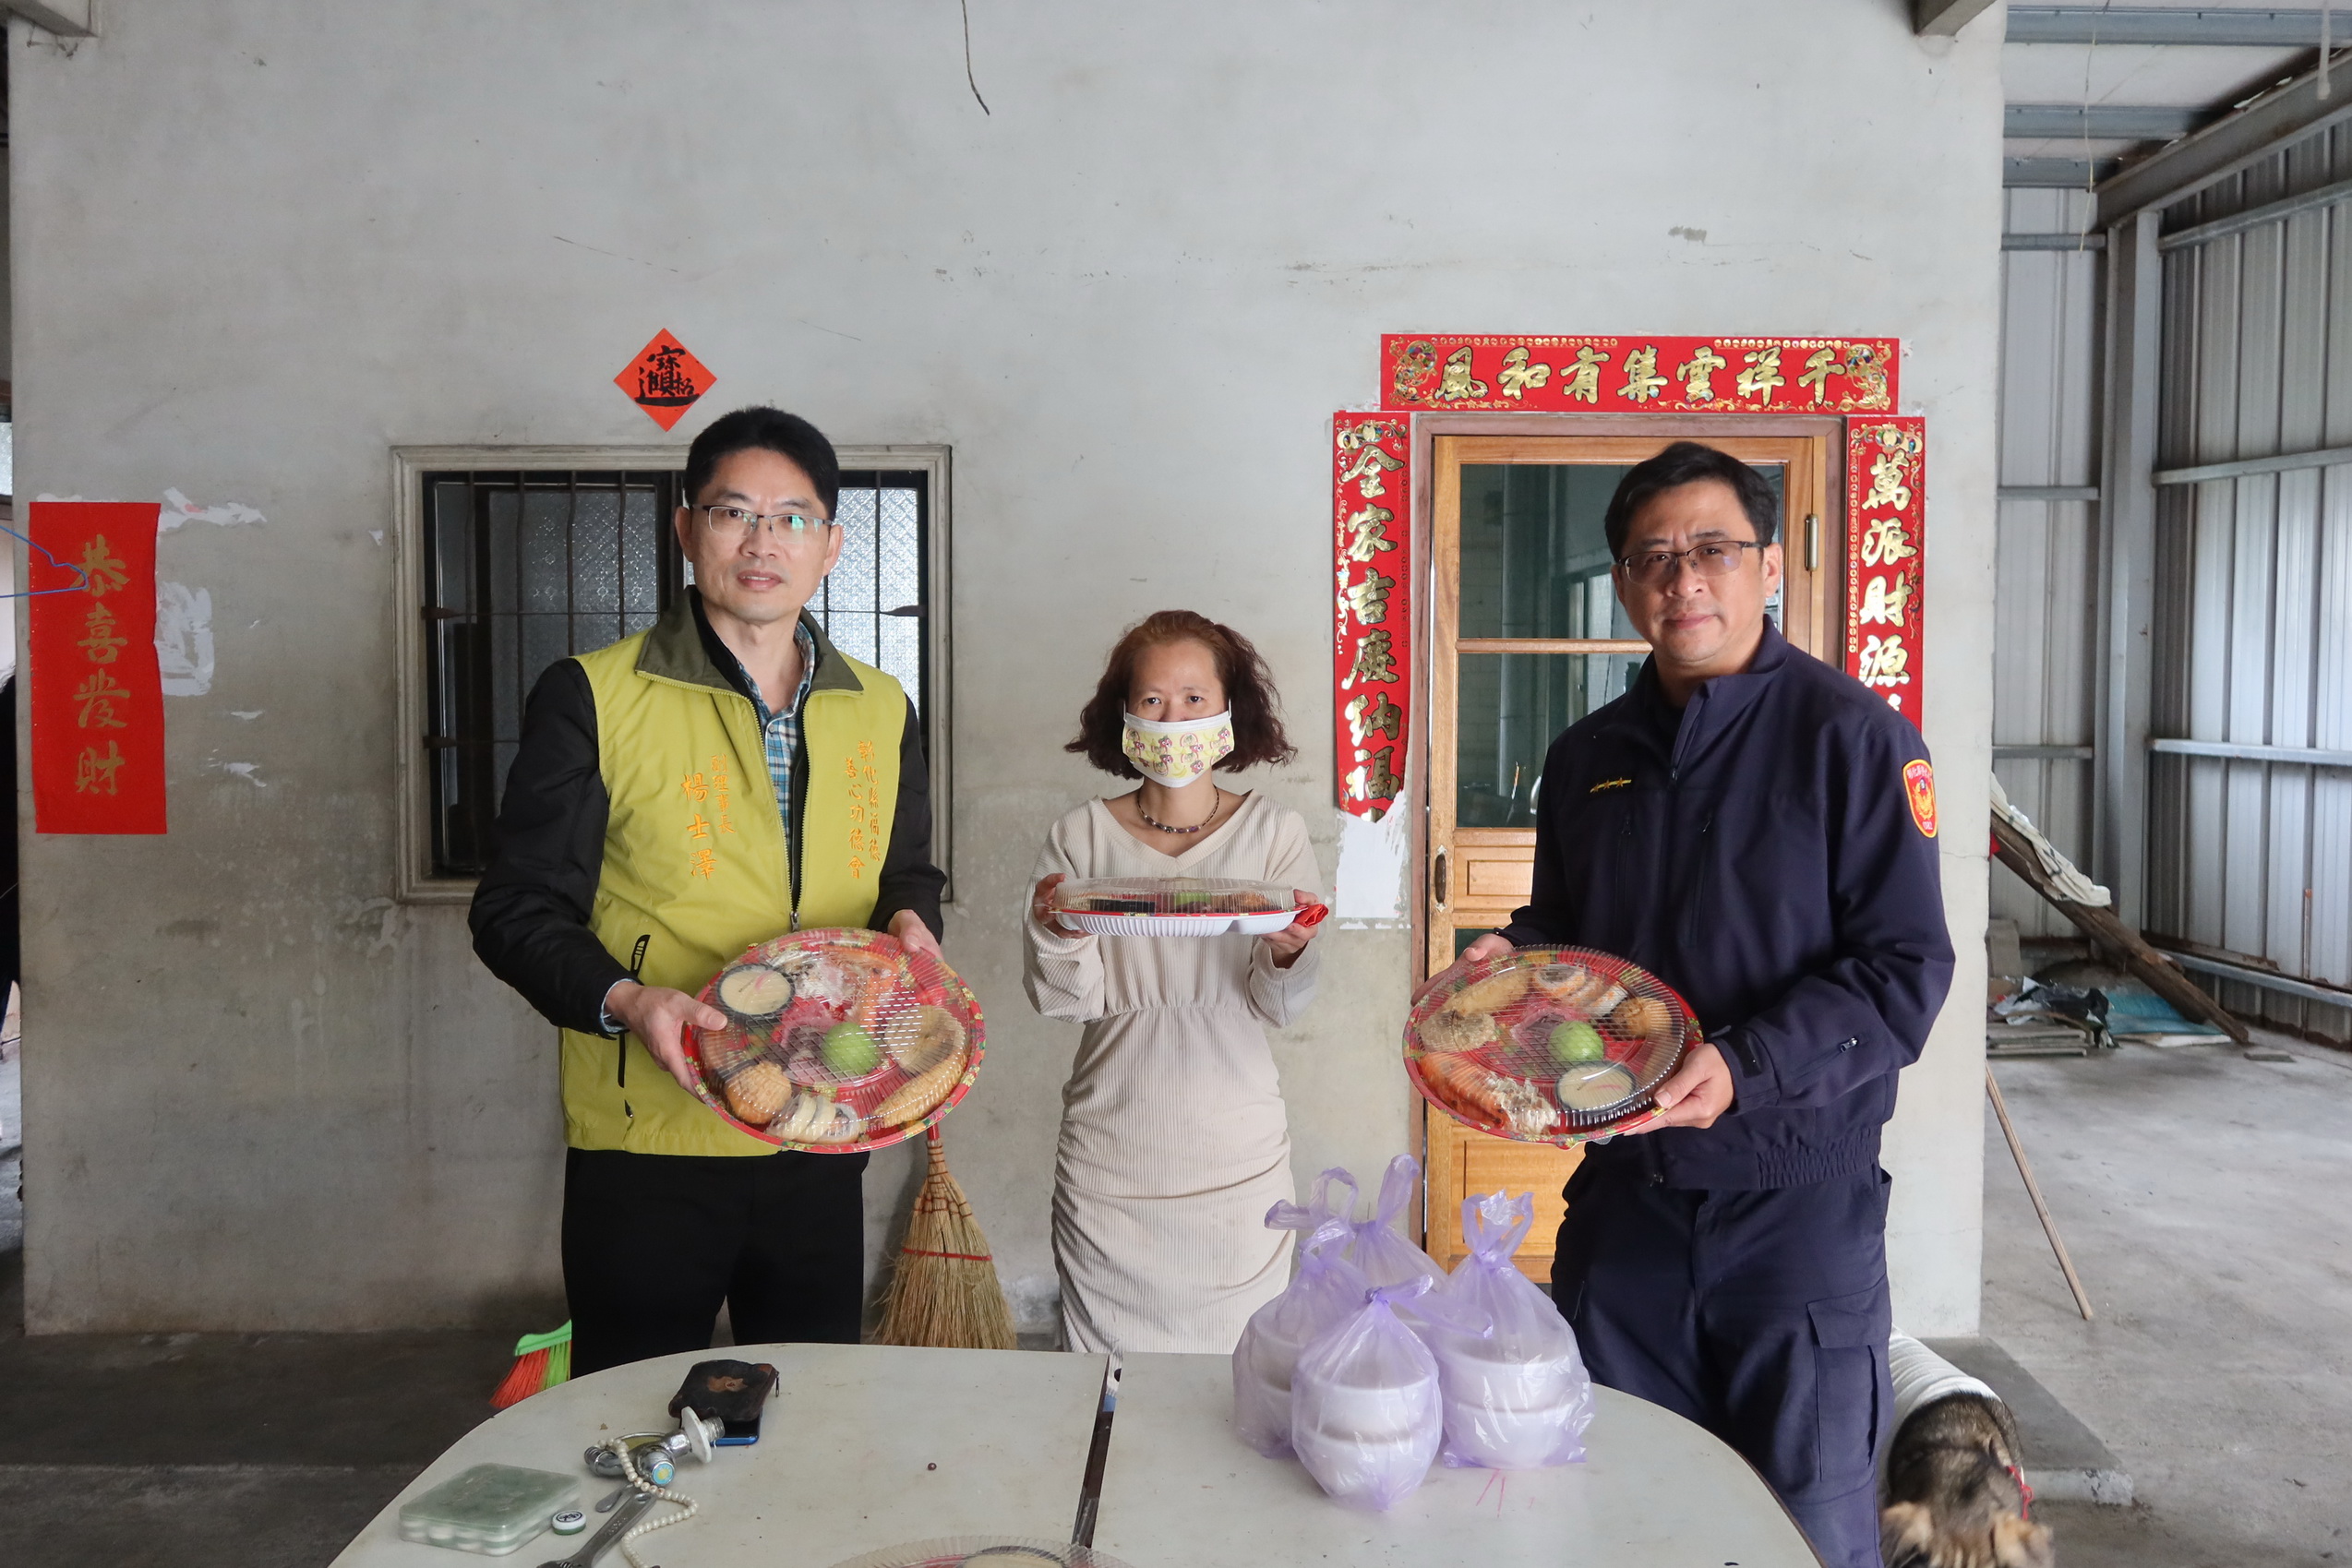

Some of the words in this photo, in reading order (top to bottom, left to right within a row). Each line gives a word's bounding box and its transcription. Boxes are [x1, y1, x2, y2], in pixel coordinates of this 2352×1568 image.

[1858, 449, 1919, 712] 萬派財源
[69, 533, 131, 796] 恭喜發財
[680, 772, 717, 880] 楊士澤
[711, 753, 736, 834] 副理事長
[844, 756, 866, 880] 善心功德會
